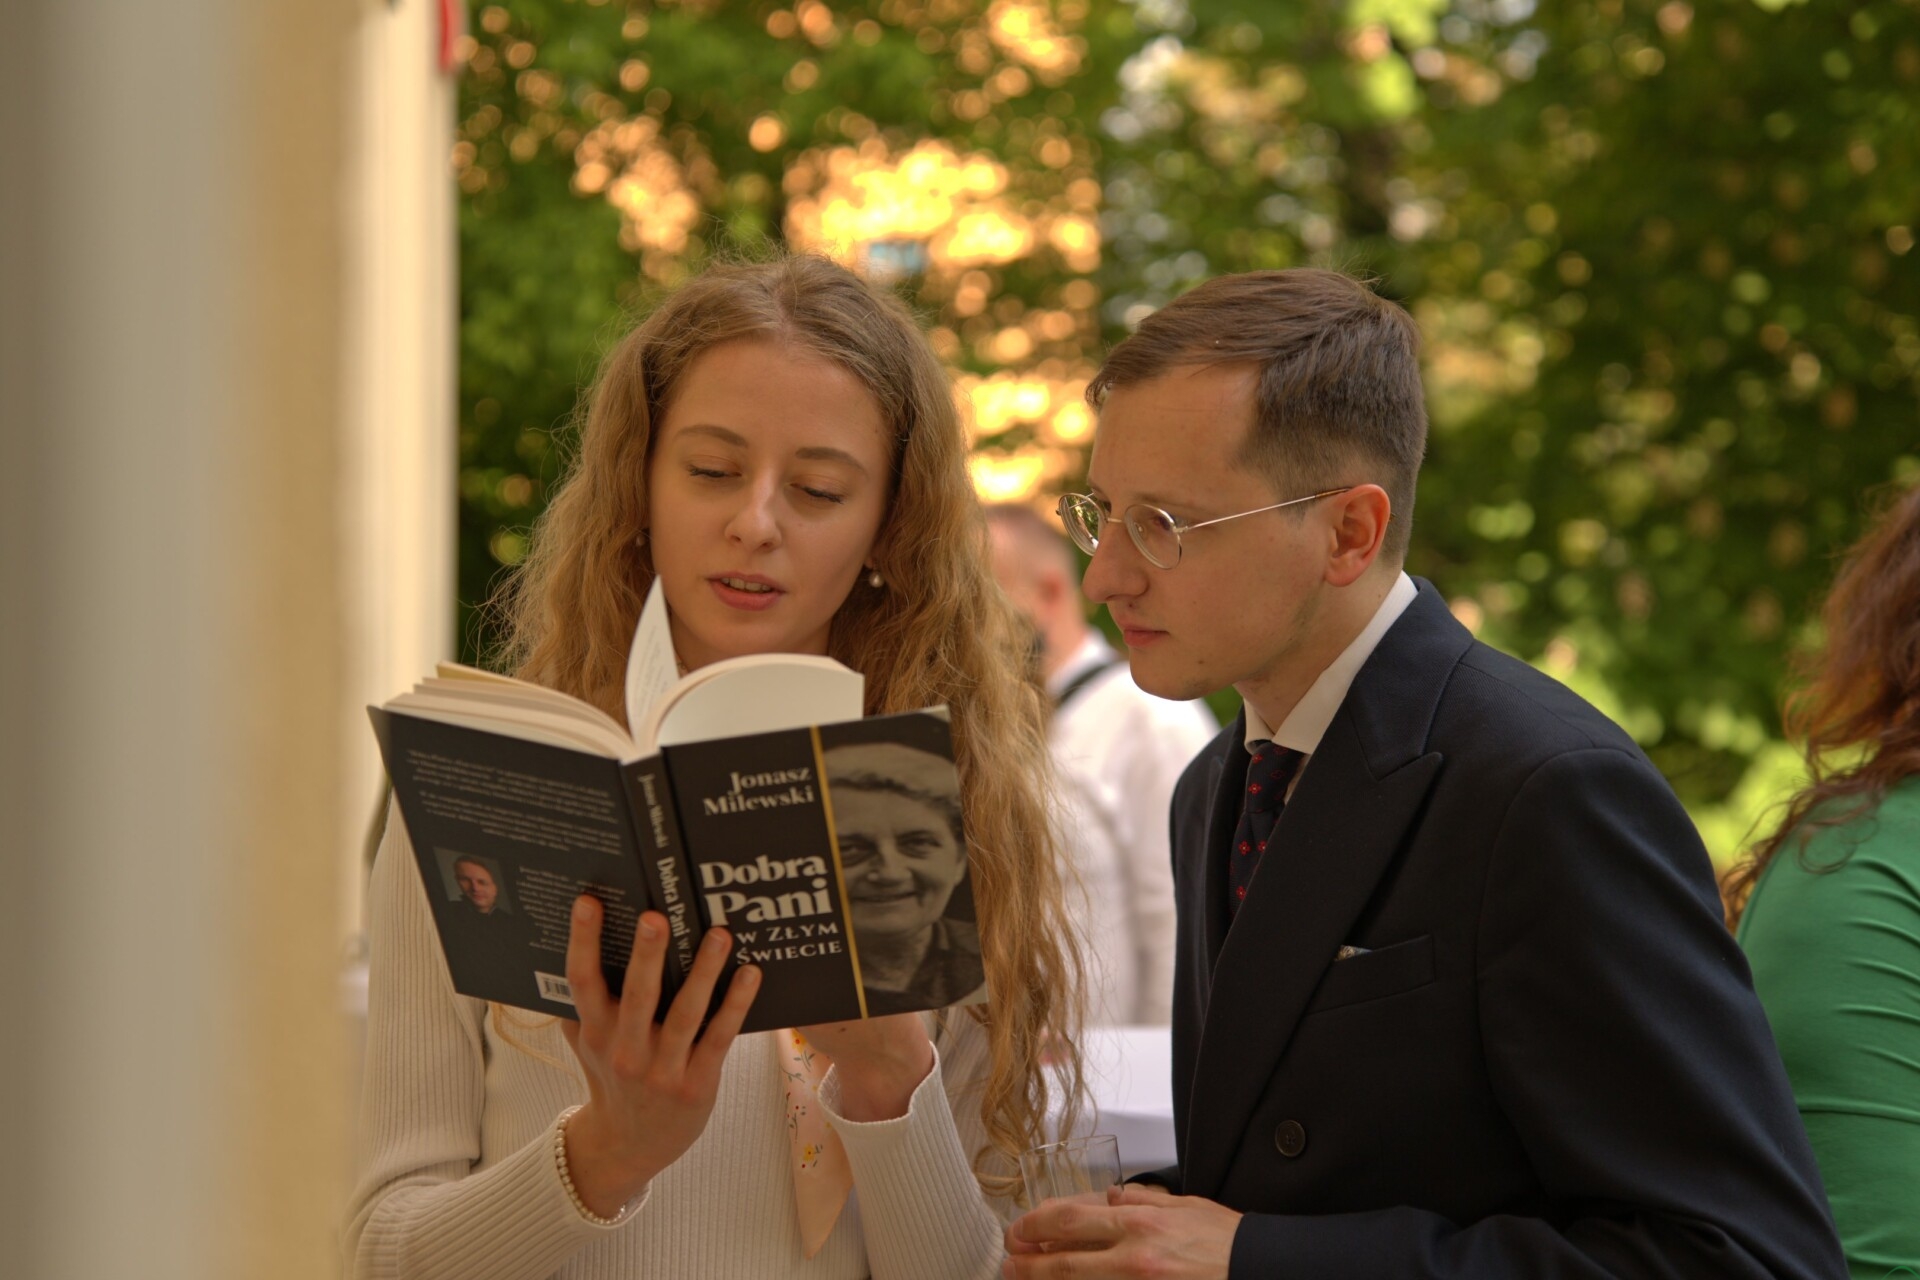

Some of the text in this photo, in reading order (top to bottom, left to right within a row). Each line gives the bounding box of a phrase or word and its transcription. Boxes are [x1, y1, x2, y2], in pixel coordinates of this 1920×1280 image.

[730, 767, 812, 795] Jonasz
[703, 785, 814, 816] Milewski
[657, 857, 679, 904] Dobra
[699, 854, 829, 889] Dobra
[704, 877, 833, 927] Pani
[667, 902, 691, 937] Pani
[766, 922, 839, 942] ZŁYM
[736, 940, 842, 965] ŚWIECIE
